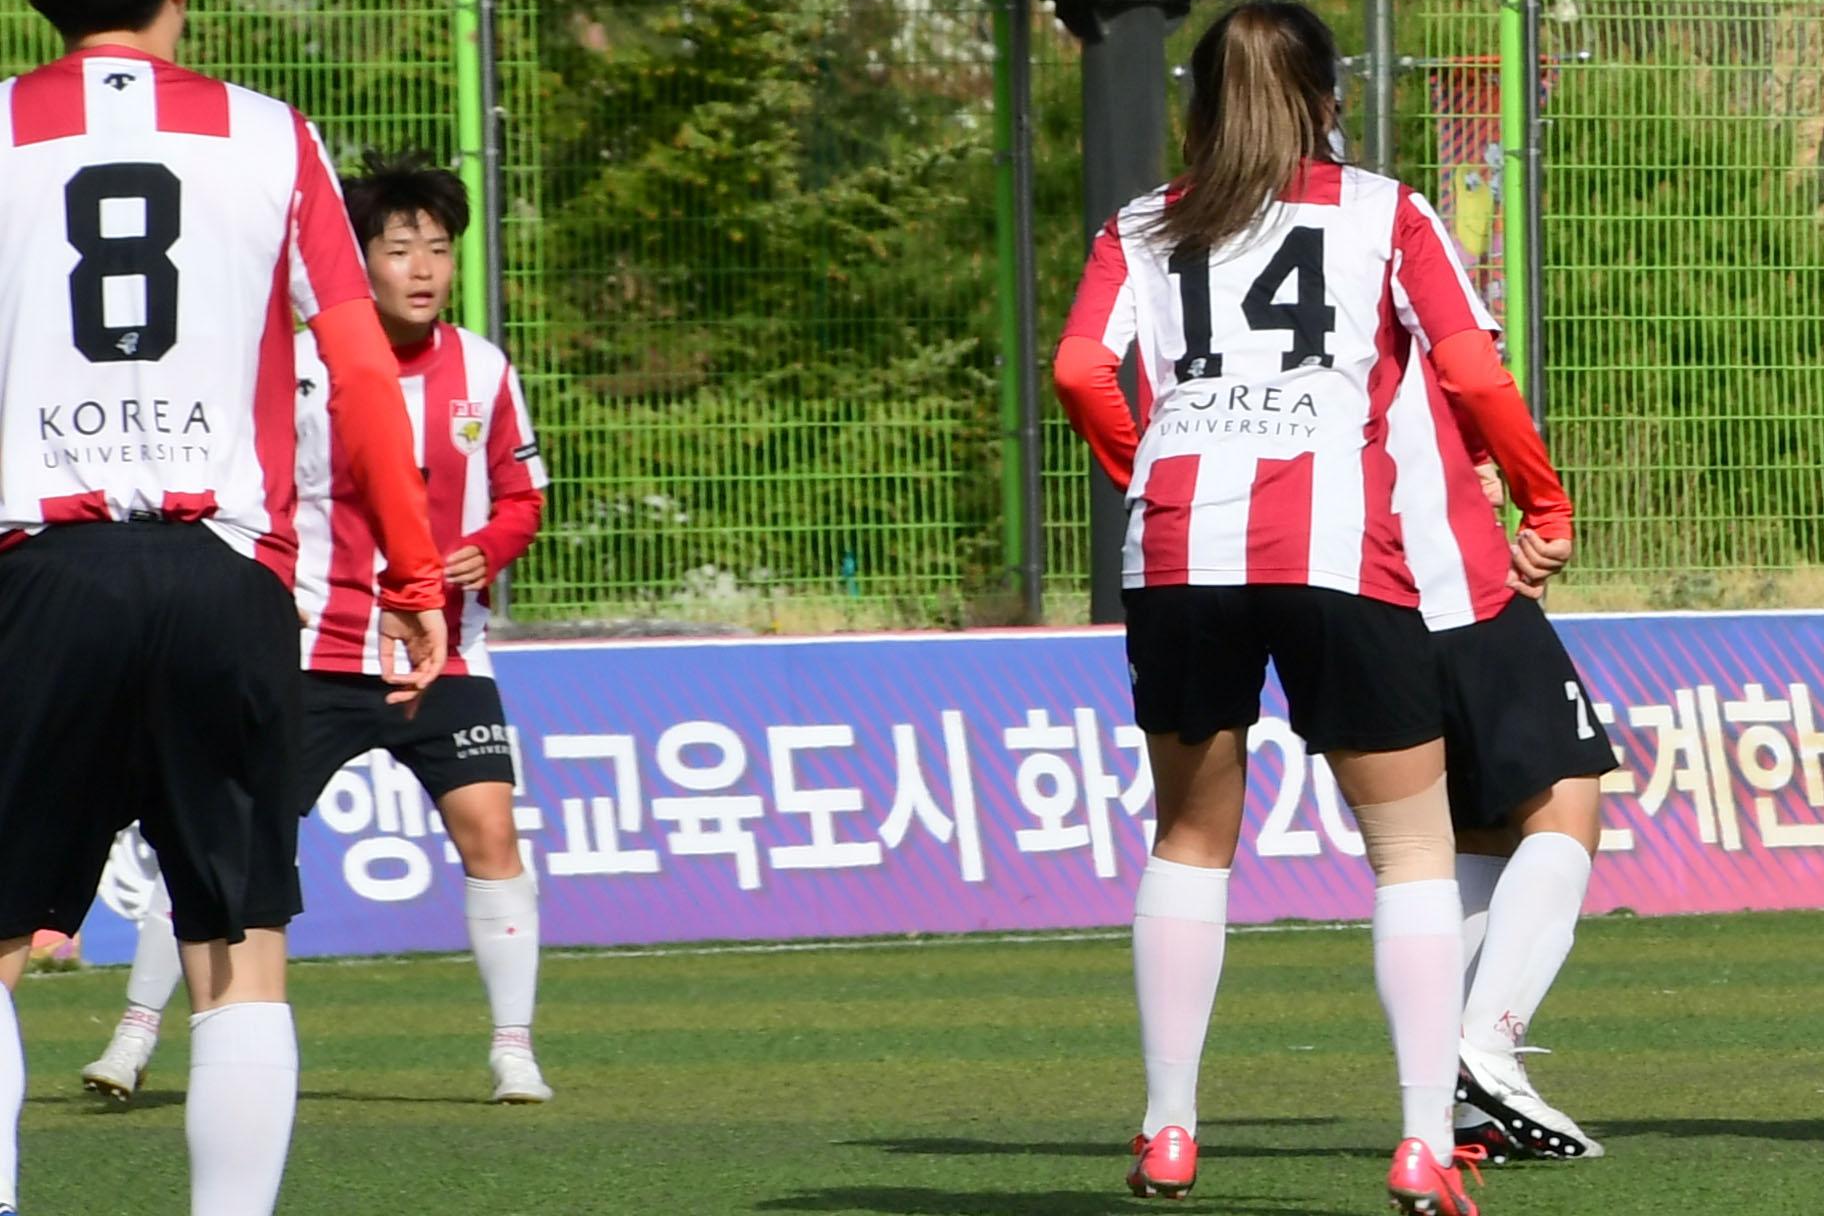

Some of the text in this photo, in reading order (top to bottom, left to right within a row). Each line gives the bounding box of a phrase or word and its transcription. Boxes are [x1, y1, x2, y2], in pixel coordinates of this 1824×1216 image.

[64, 162, 181, 363] 8
[1168, 226, 1336, 384] 14
[38, 399, 211, 441] KOREA
[1160, 419, 1317, 439] UNIVERSITY
[44, 443, 210, 469] UNIVERSITY
